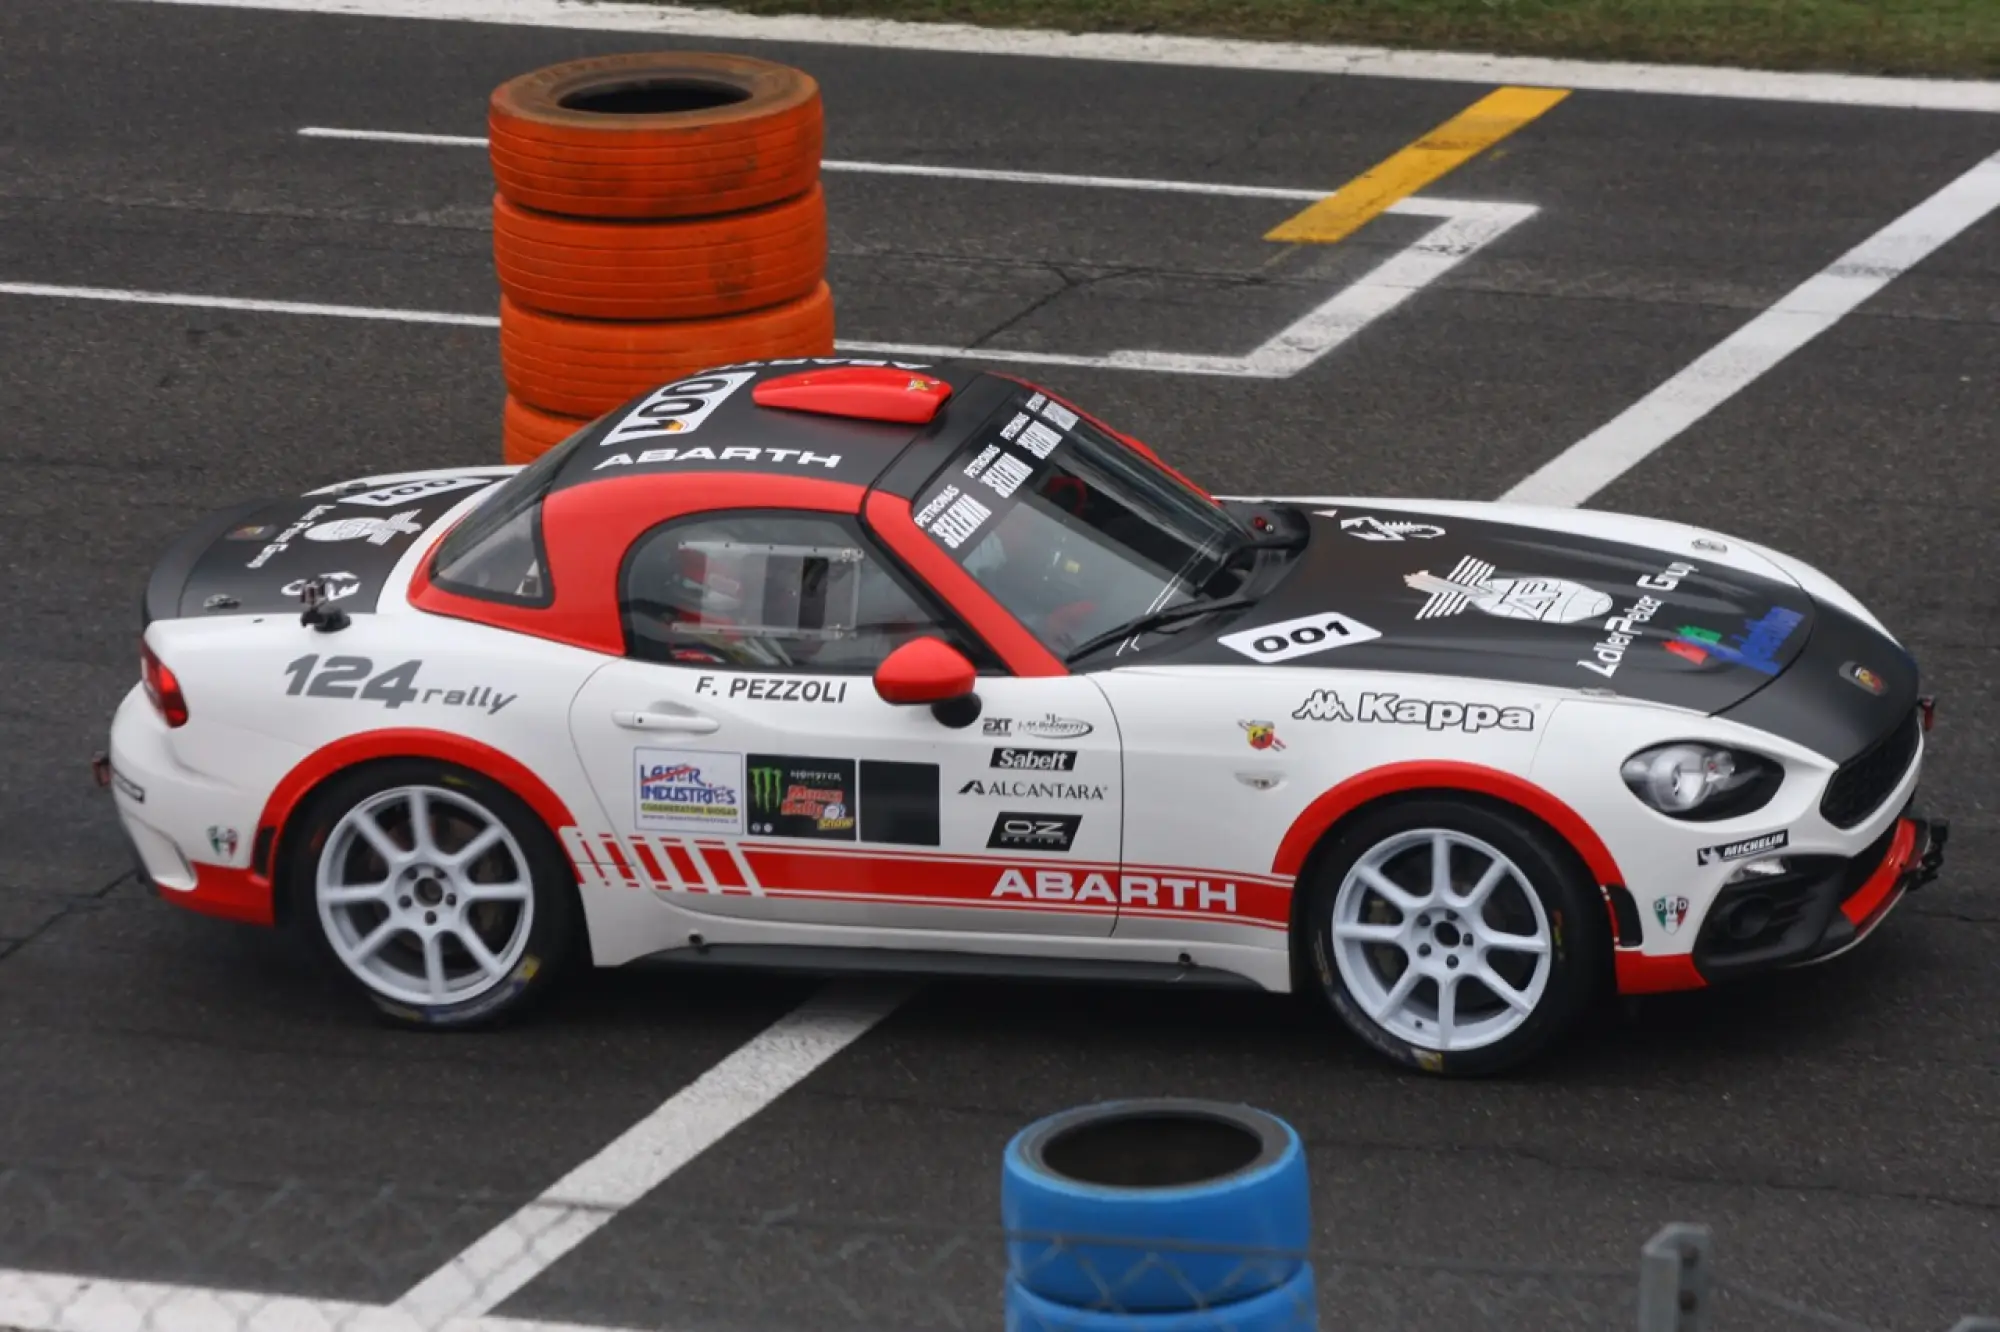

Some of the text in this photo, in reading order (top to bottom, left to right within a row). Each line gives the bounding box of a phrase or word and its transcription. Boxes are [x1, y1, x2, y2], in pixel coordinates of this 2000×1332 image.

[592, 447, 843, 470] ABARTH
[913, 484, 960, 528] PETRONAS
[1253, 621, 1351, 653] 001
[285, 654, 518, 715] 124 rally
[696, 676, 847, 704] F. PEZZOLI
[1358, 692, 1534, 732] Kappa
[999, 748, 1068, 770] Sabelt
[989, 781, 1104, 800] ALCANTARA
[1724, 833, 1785, 857] MICHELIN
[990, 868, 1237, 912] ABARTH
